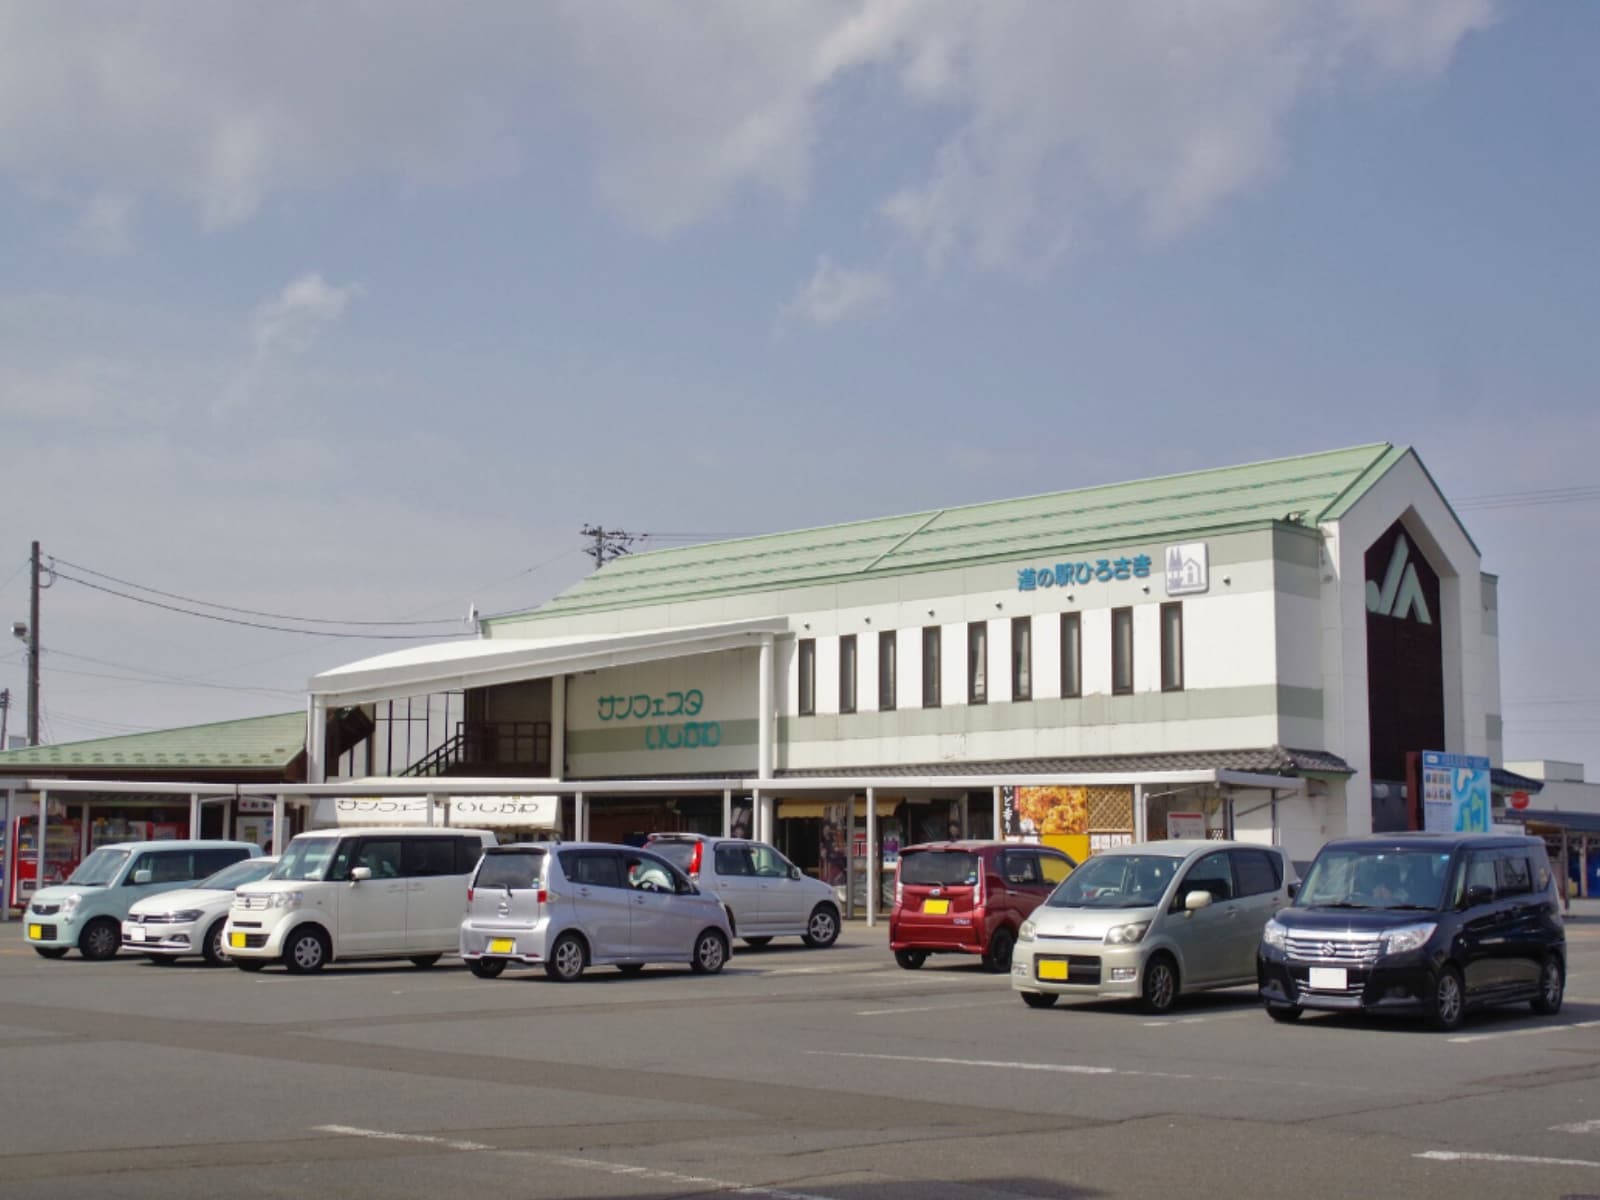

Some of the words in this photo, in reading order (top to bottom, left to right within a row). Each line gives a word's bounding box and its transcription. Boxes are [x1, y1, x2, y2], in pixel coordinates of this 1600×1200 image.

[1017, 554, 1152, 592] 道の駅ひろさき
[597, 688, 705, 721] サンフェスタ
